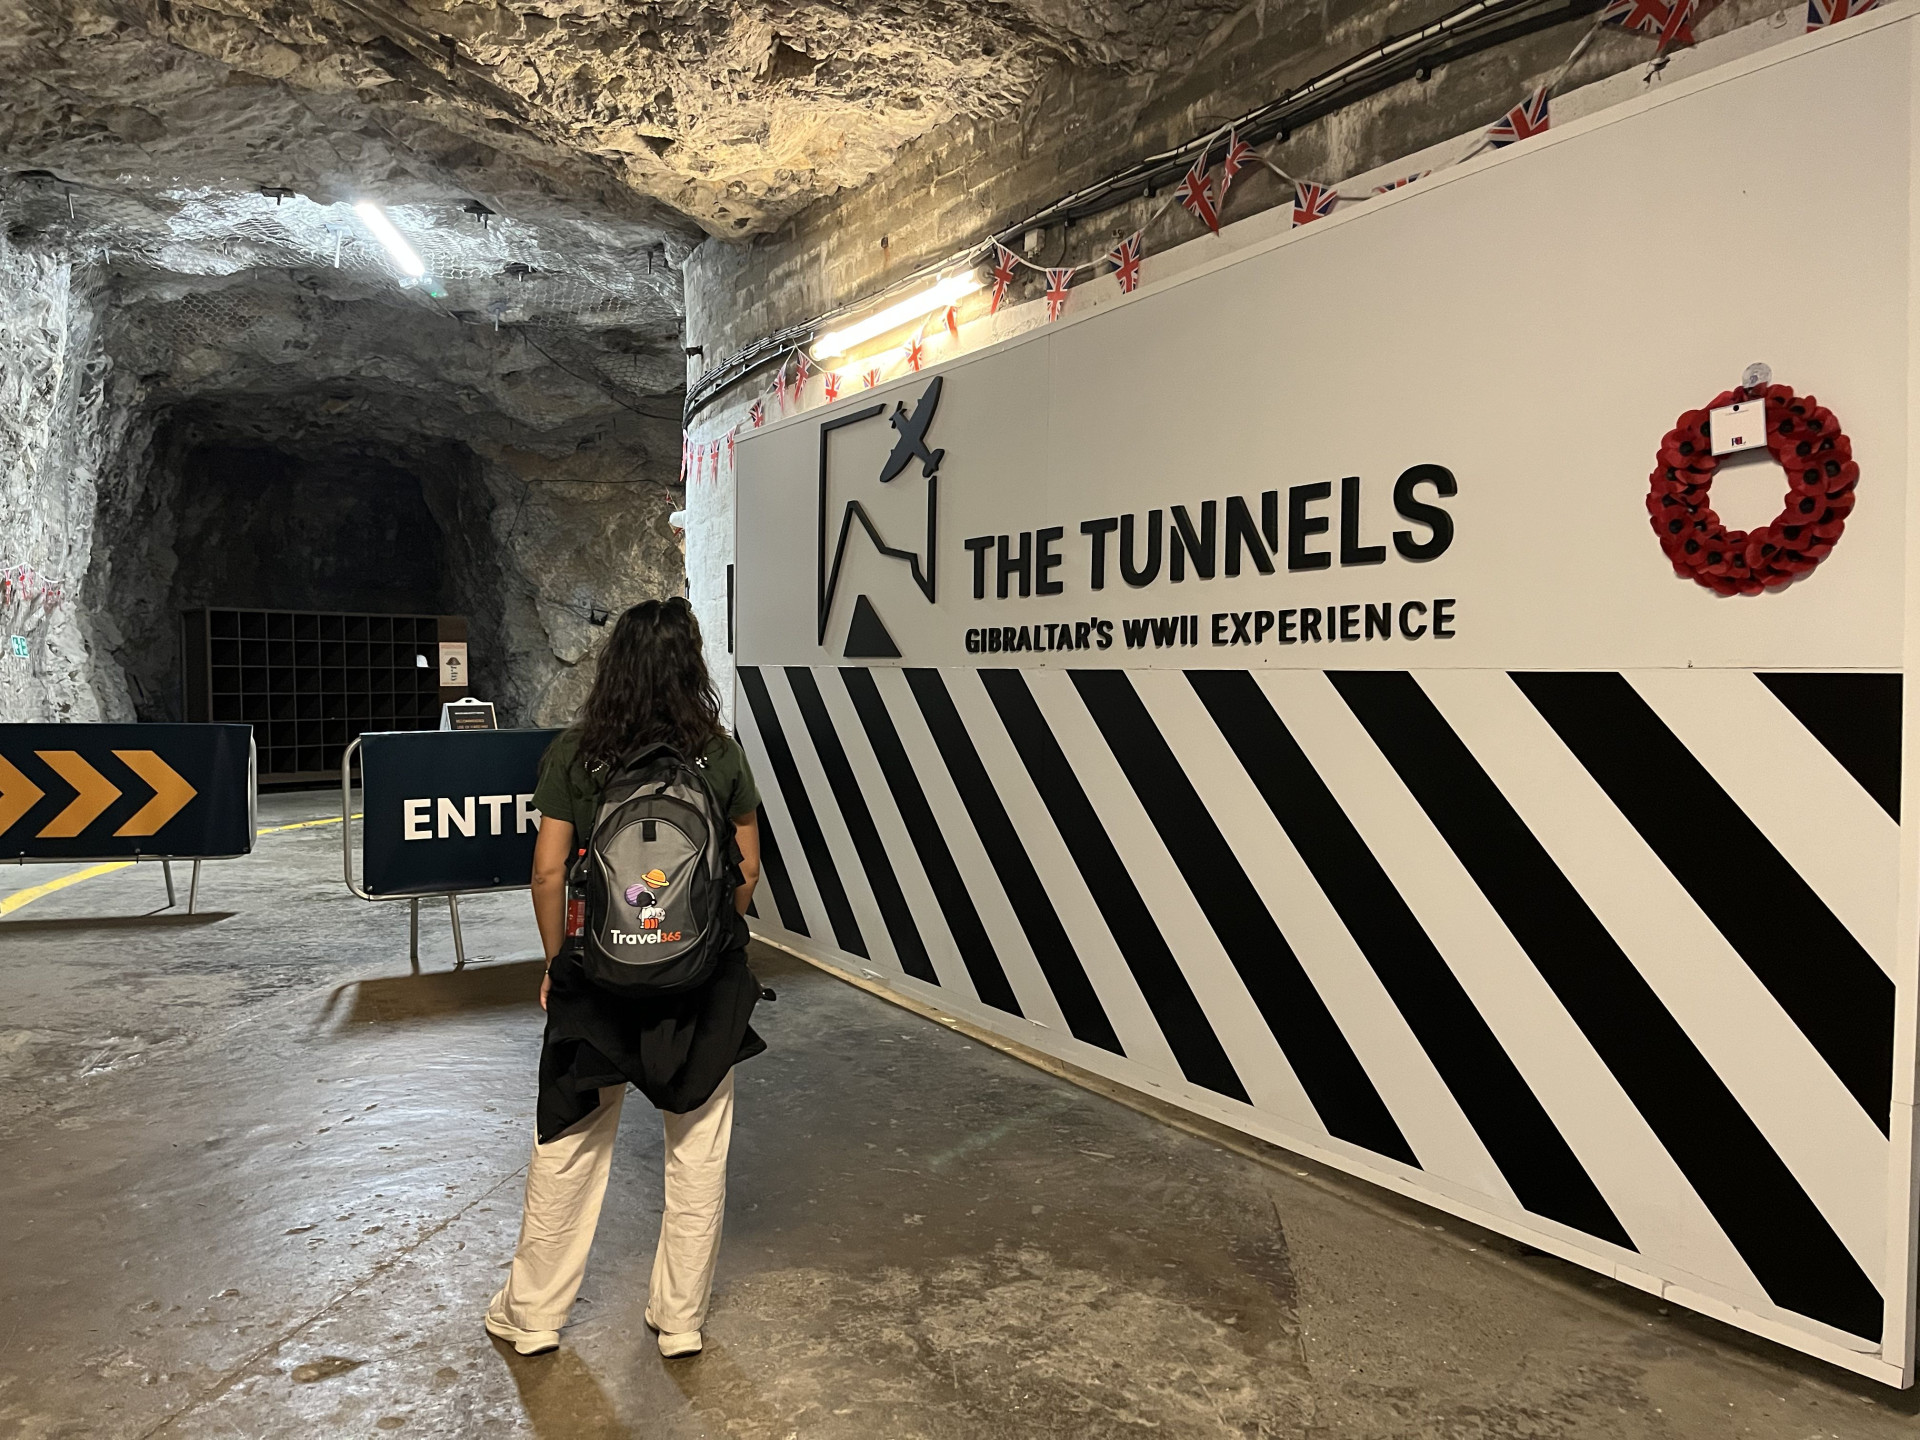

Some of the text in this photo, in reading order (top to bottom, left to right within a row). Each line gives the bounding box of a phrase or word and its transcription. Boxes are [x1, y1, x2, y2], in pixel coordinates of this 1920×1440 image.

[964, 463, 1458, 600] THE TUNNELS
[965, 598, 1457, 654] GIBRALTAR'S WWII EXPERIENCE
